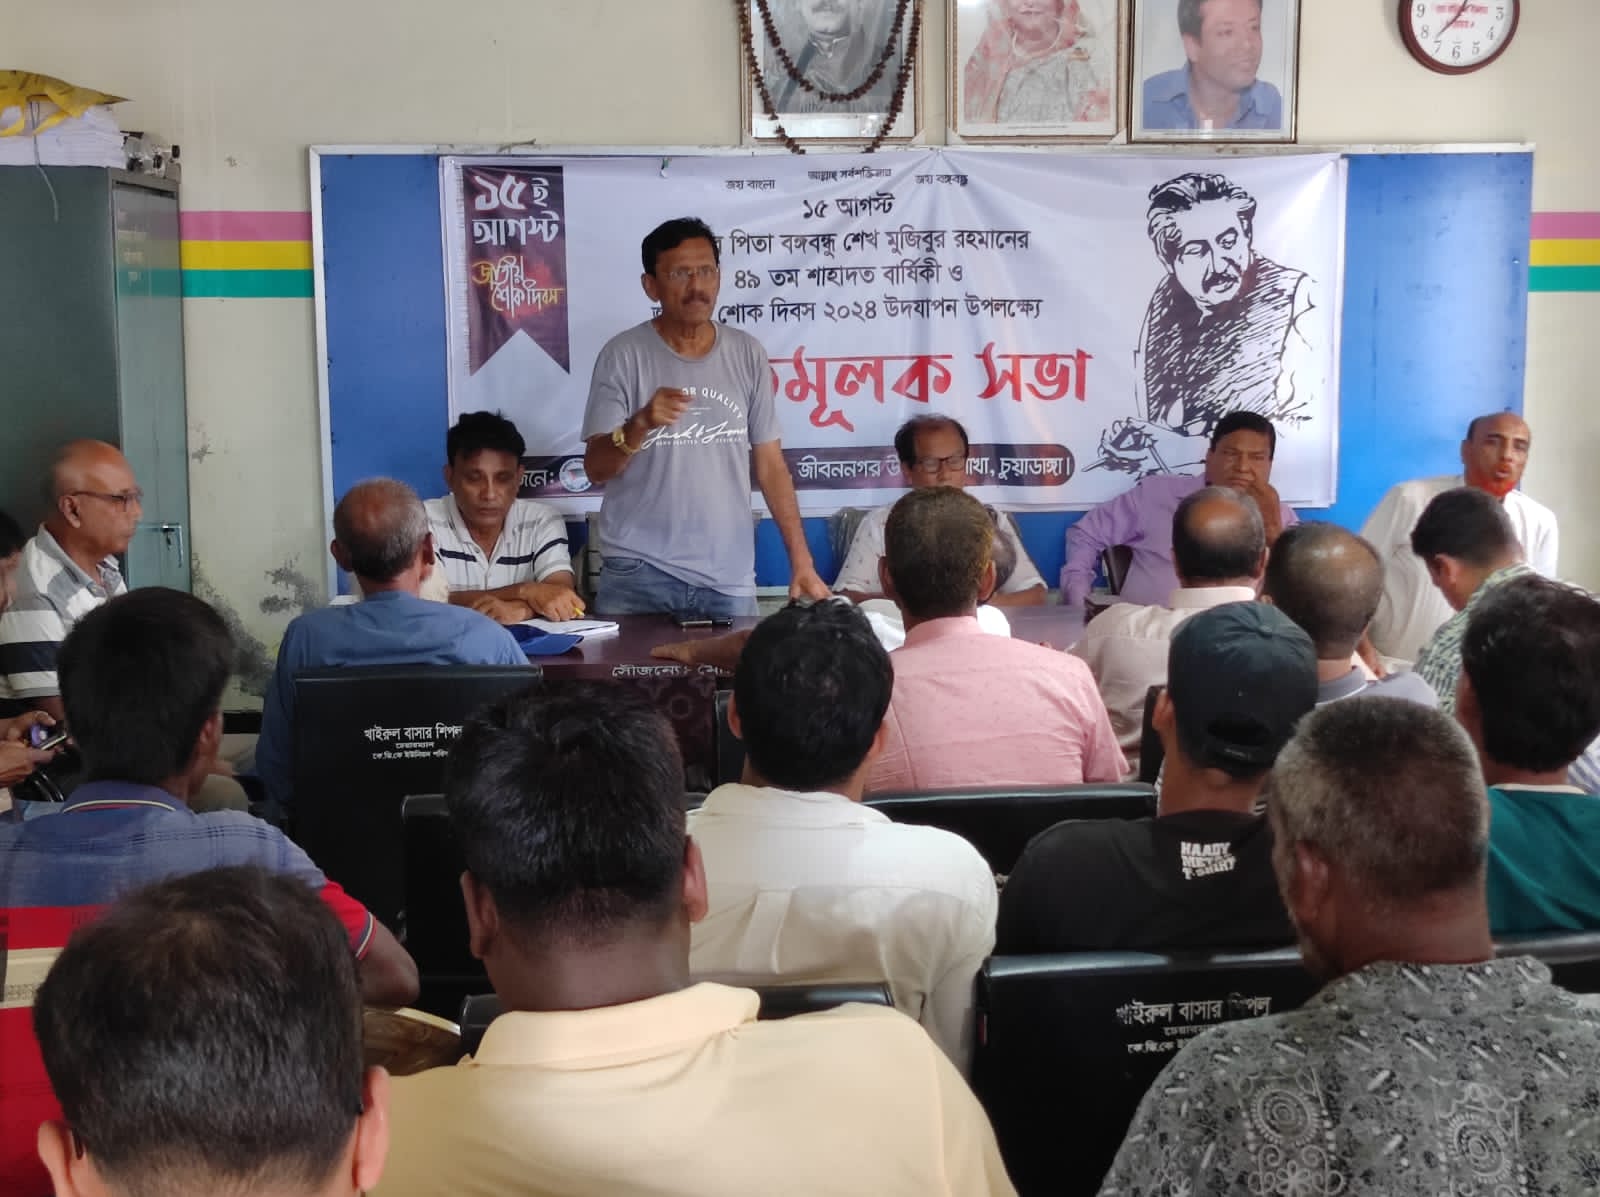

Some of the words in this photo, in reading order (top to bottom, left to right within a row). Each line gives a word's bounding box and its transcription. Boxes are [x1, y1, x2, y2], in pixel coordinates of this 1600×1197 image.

[747, 178, 776, 190] বাংলা
[802, 198, 828, 219] ১৫
[835, 191, 896, 217] আগস্ট
[472, 210, 560, 246] আগস্ট
[729, 229, 774, 255] পিতা
[780, 232, 838, 258] বঙ্গবন্ধু
[843, 231, 880, 252] শেখ
[887, 227, 948, 258] মুজিবুর
[952, 229, 1032, 252] রহমানের
[734, 269, 761, 289] ৪৯
[767, 267, 801, 288] তম
[807, 265, 876, 287] শাহাদত
[883, 257, 942, 286] বার্ষিকী
[948, 266, 964, 282] ও
[718, 304, 764, 326] শোক
[769, 299, 817, 323] দিবস
[824, 301, 877, 321] ২০২৪
[883, 293, 960, 320] উদযাপন
[974, 341, 1094, 402] সভা
[702, 387, 743, 418] QUALITY
[796, 454, 881, 480] জীবননগর
[403, 726, 433, 740] বাসার
[1178, 1000, 1224, 1022] বাসার
